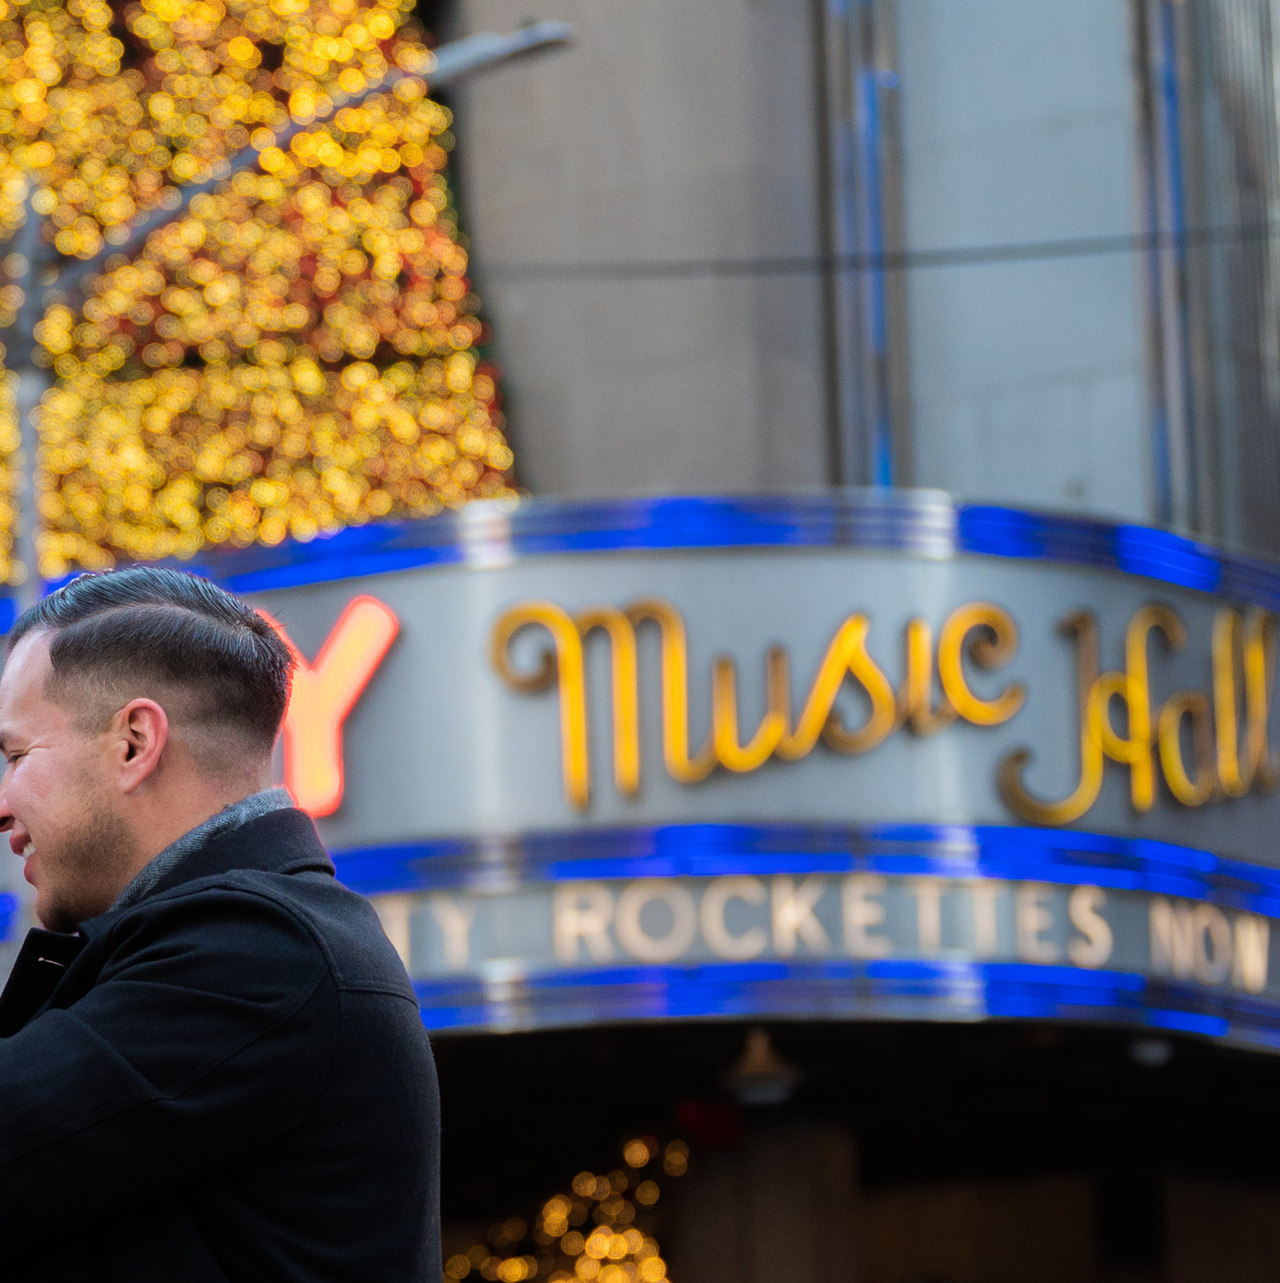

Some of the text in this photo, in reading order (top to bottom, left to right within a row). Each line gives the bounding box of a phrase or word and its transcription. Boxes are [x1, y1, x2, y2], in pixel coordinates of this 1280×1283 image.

[491, 597, 1027, 812] Music
[996, 602, 1280, 826] Hall
[372, 890, 475, 974] TY
[551, 874, 1116, 970] ROCKETTES
